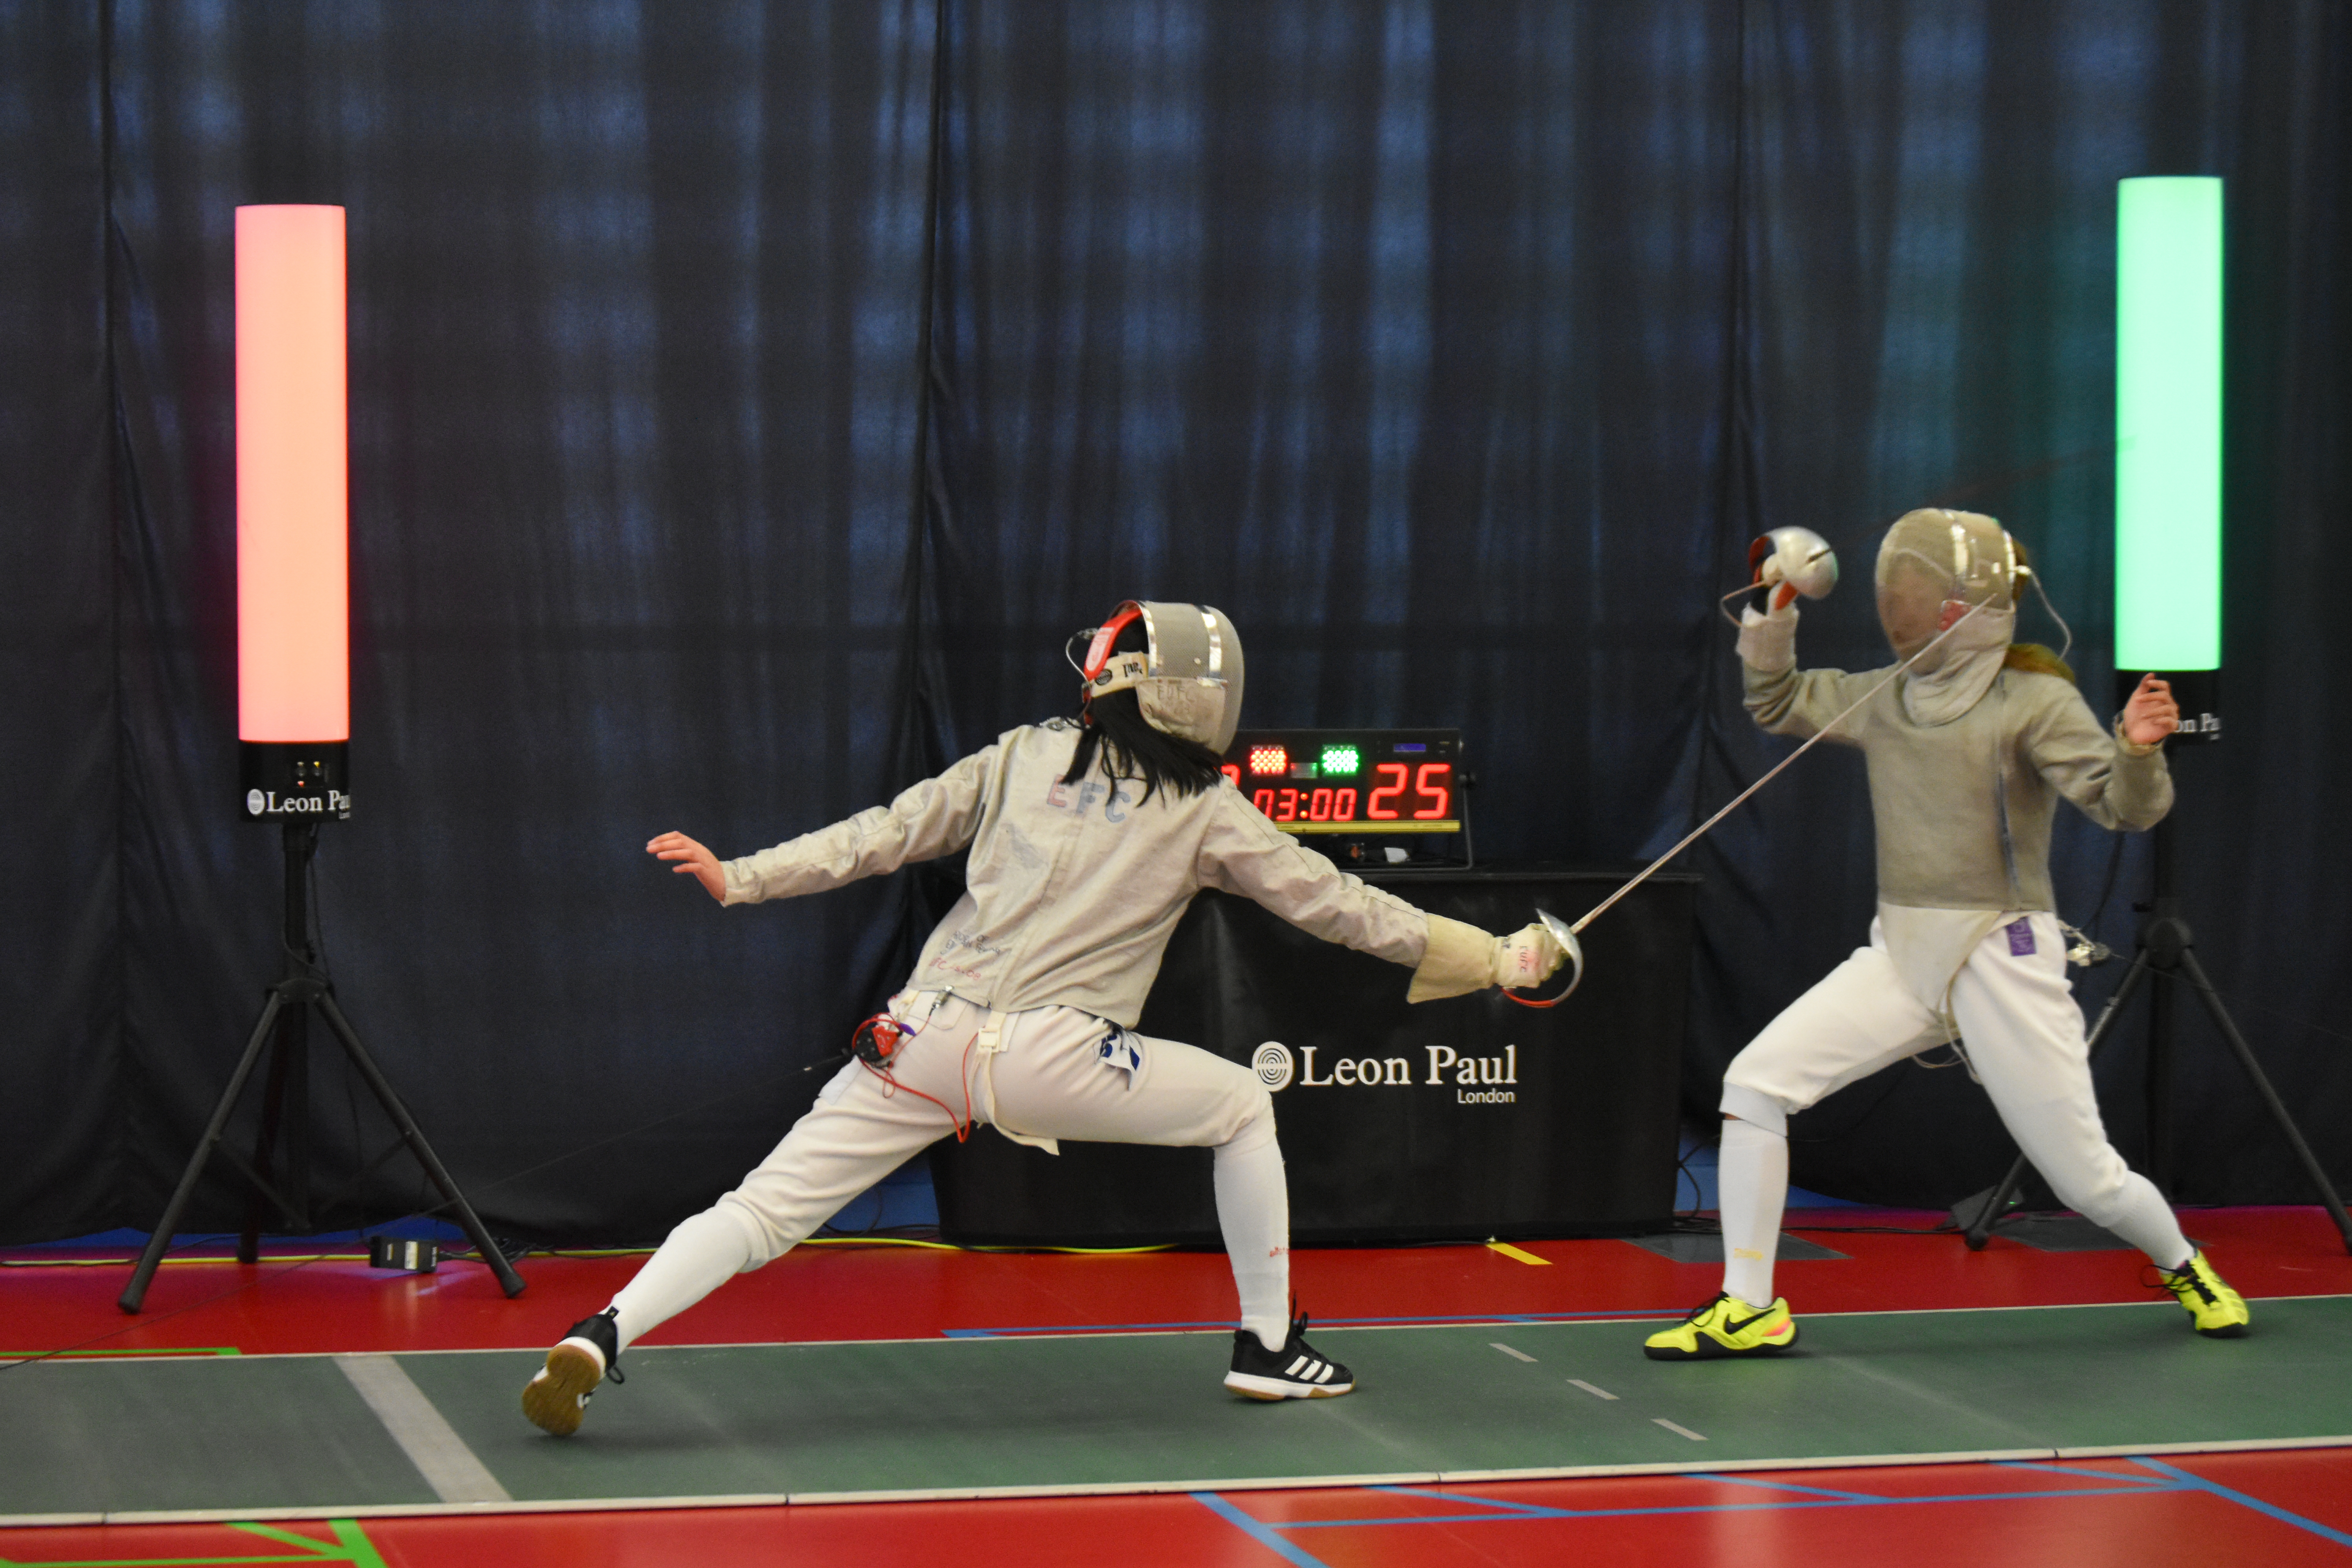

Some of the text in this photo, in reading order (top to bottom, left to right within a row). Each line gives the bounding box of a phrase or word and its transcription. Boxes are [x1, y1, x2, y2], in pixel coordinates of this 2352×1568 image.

[266, 791, 323, 812] Leon
[1254, 789, 1357, 822] 03:00
[1367, 763, 1450, 819] 25
[1299, 1044, 1517, 1085] Leon Paul
[1457, 1087, 1516, 1104] London
